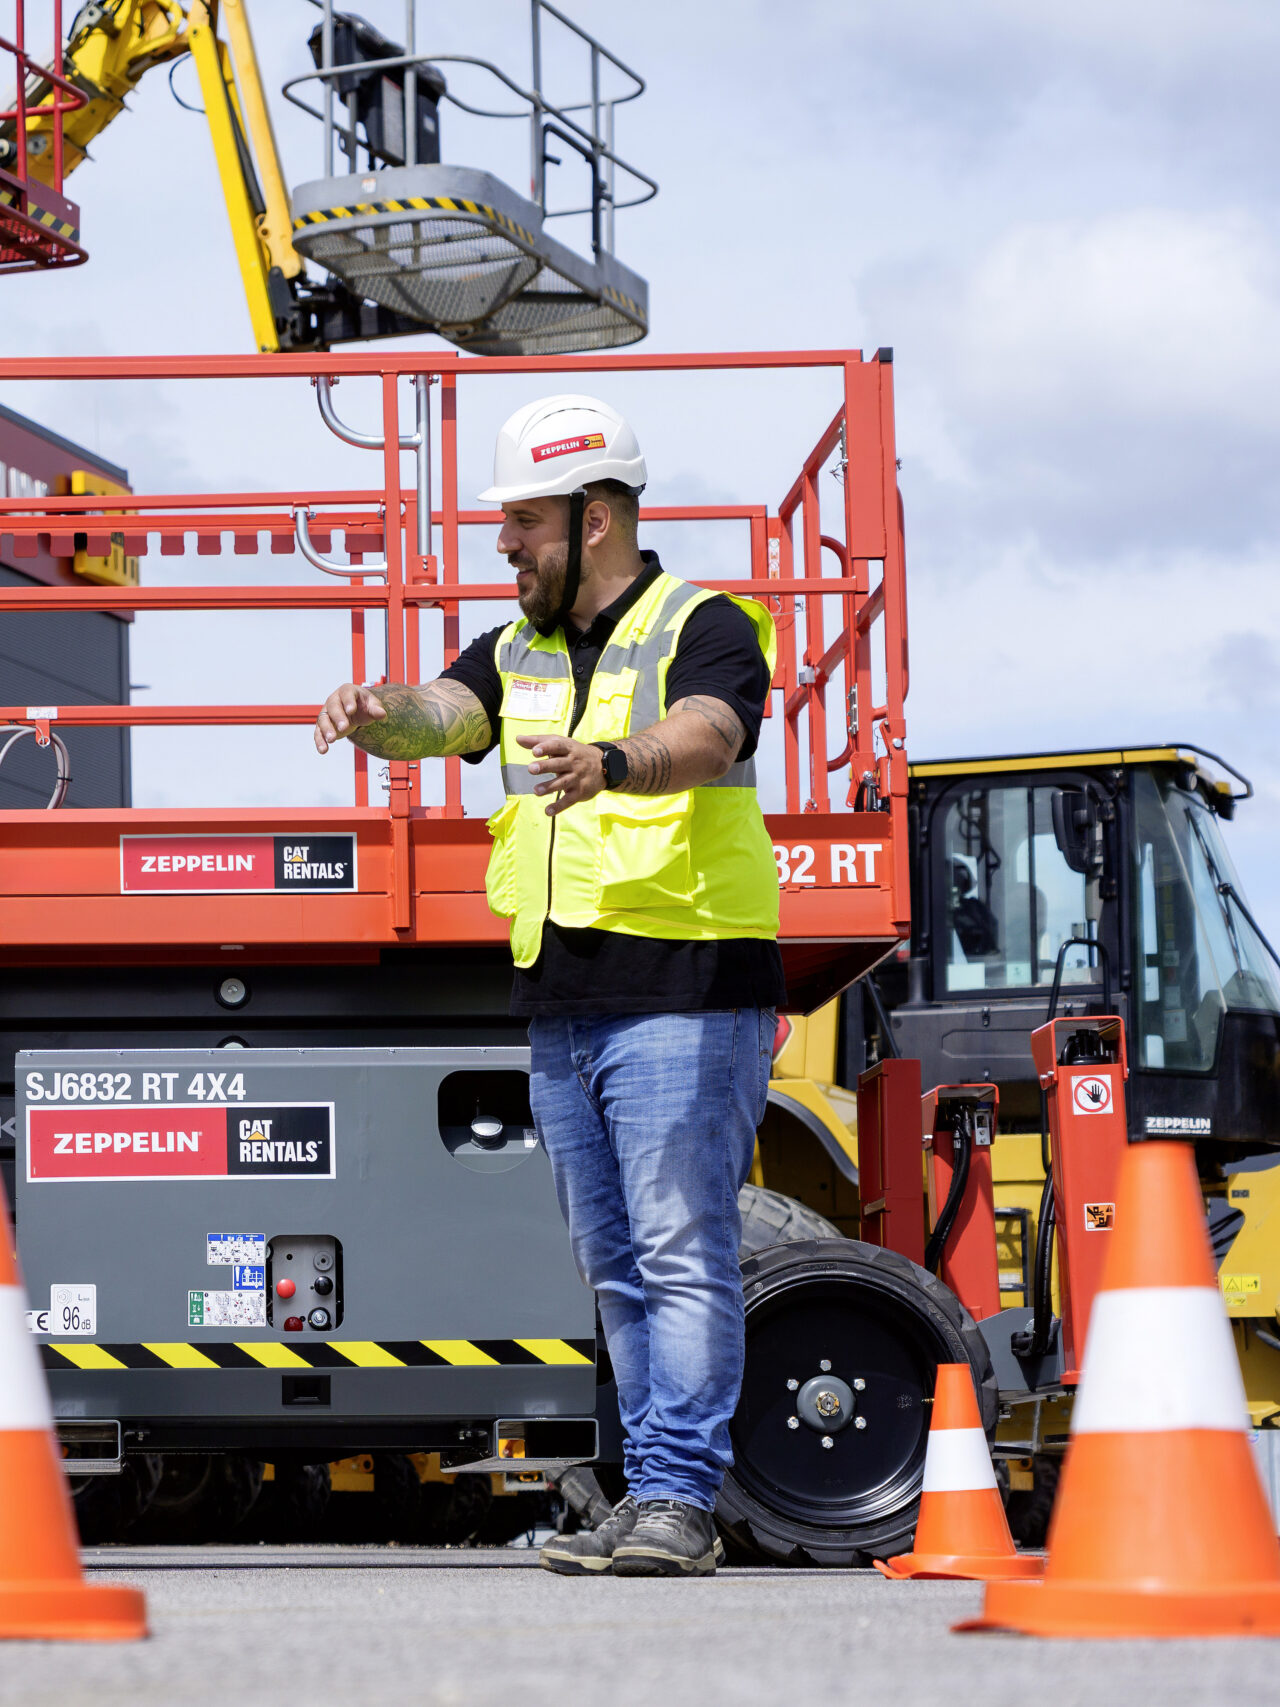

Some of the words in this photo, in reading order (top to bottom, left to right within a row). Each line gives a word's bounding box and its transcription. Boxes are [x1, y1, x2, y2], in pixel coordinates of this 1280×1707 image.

[541, 441, 580, 456] ZEPPELIN
[283, 846, 309, 862] CAT
[830, 844, 883, 883] RT
[283, 863, 344, 879] RENTALS
[26, 1072, 131, 1101] SJ6832
[142, 1073, 179, 1101] RT
[187, 1073, 246, 1101] 4X4
[239, 1119, 273, 1141] CAT
[1146, 1116, 1211, 1129] ZEPPELIN
[239, 1141, 318, 1163] RENTALS
[63, 1306, 80, 1330] 96
[81, 1319, 91, 1330] dB
